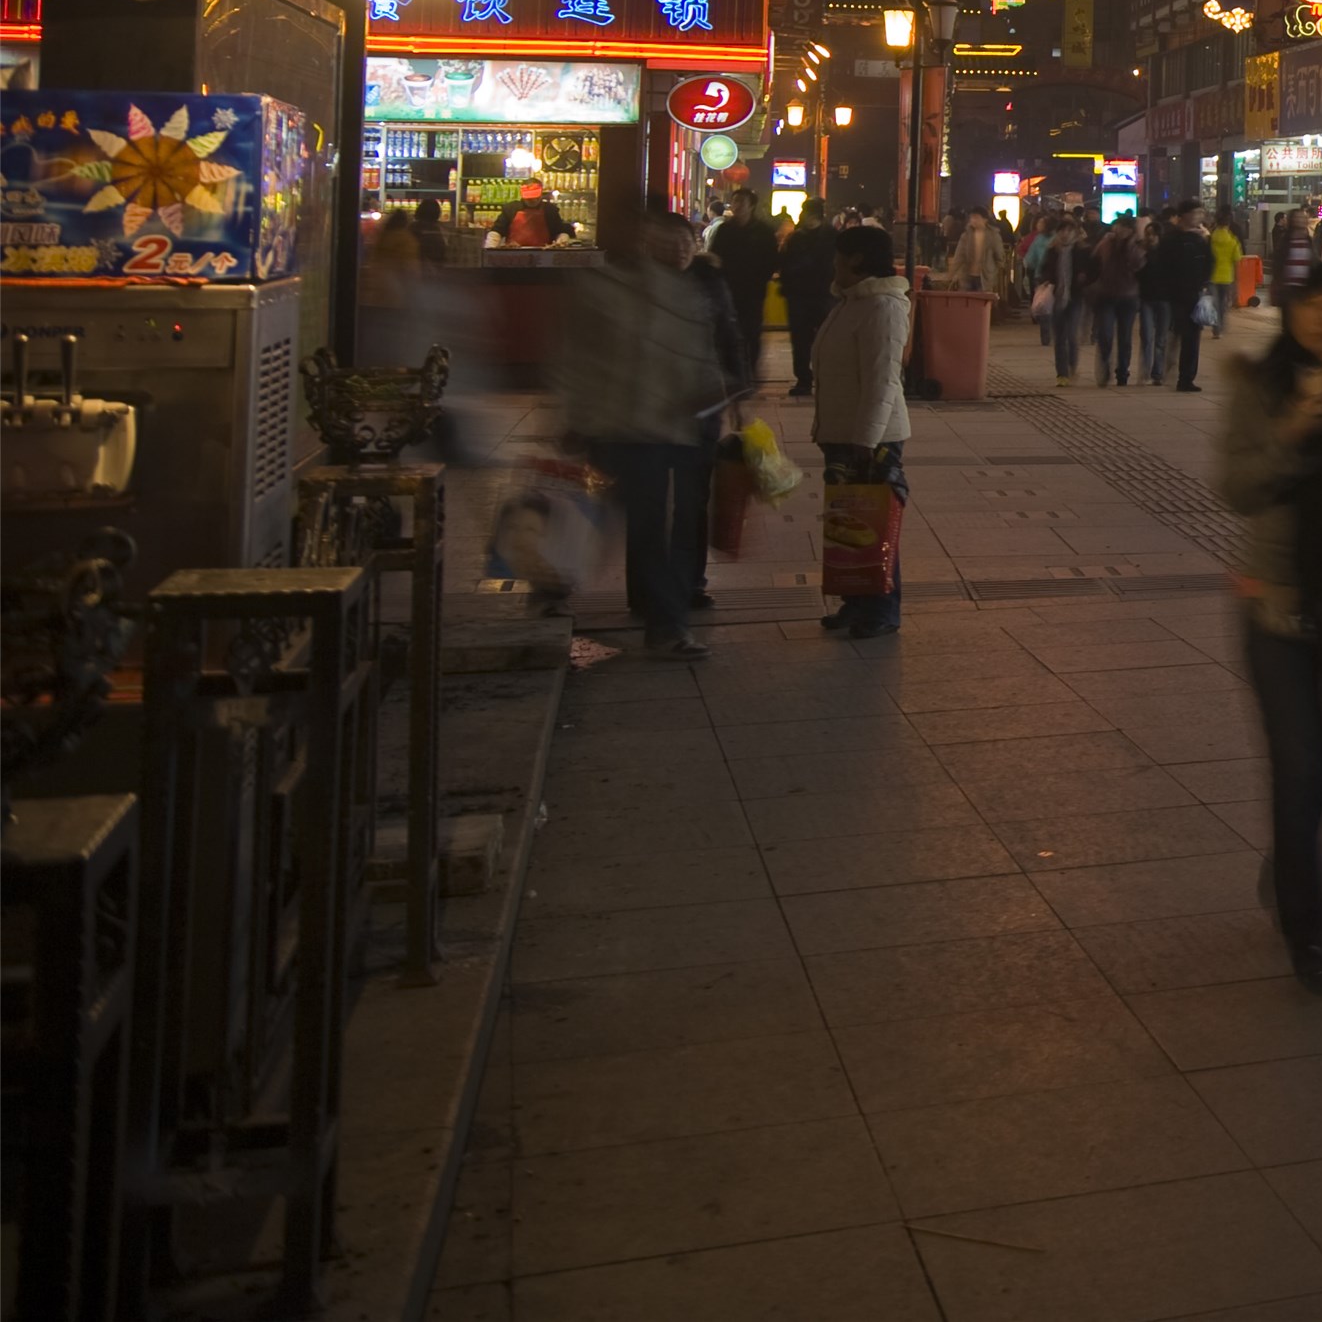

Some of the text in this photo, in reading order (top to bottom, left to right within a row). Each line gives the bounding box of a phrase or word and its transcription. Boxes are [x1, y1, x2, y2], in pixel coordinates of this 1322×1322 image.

[1265, 144, 1322, 160] 公共厕所
[123, 234, 238, 274] 2元/个
